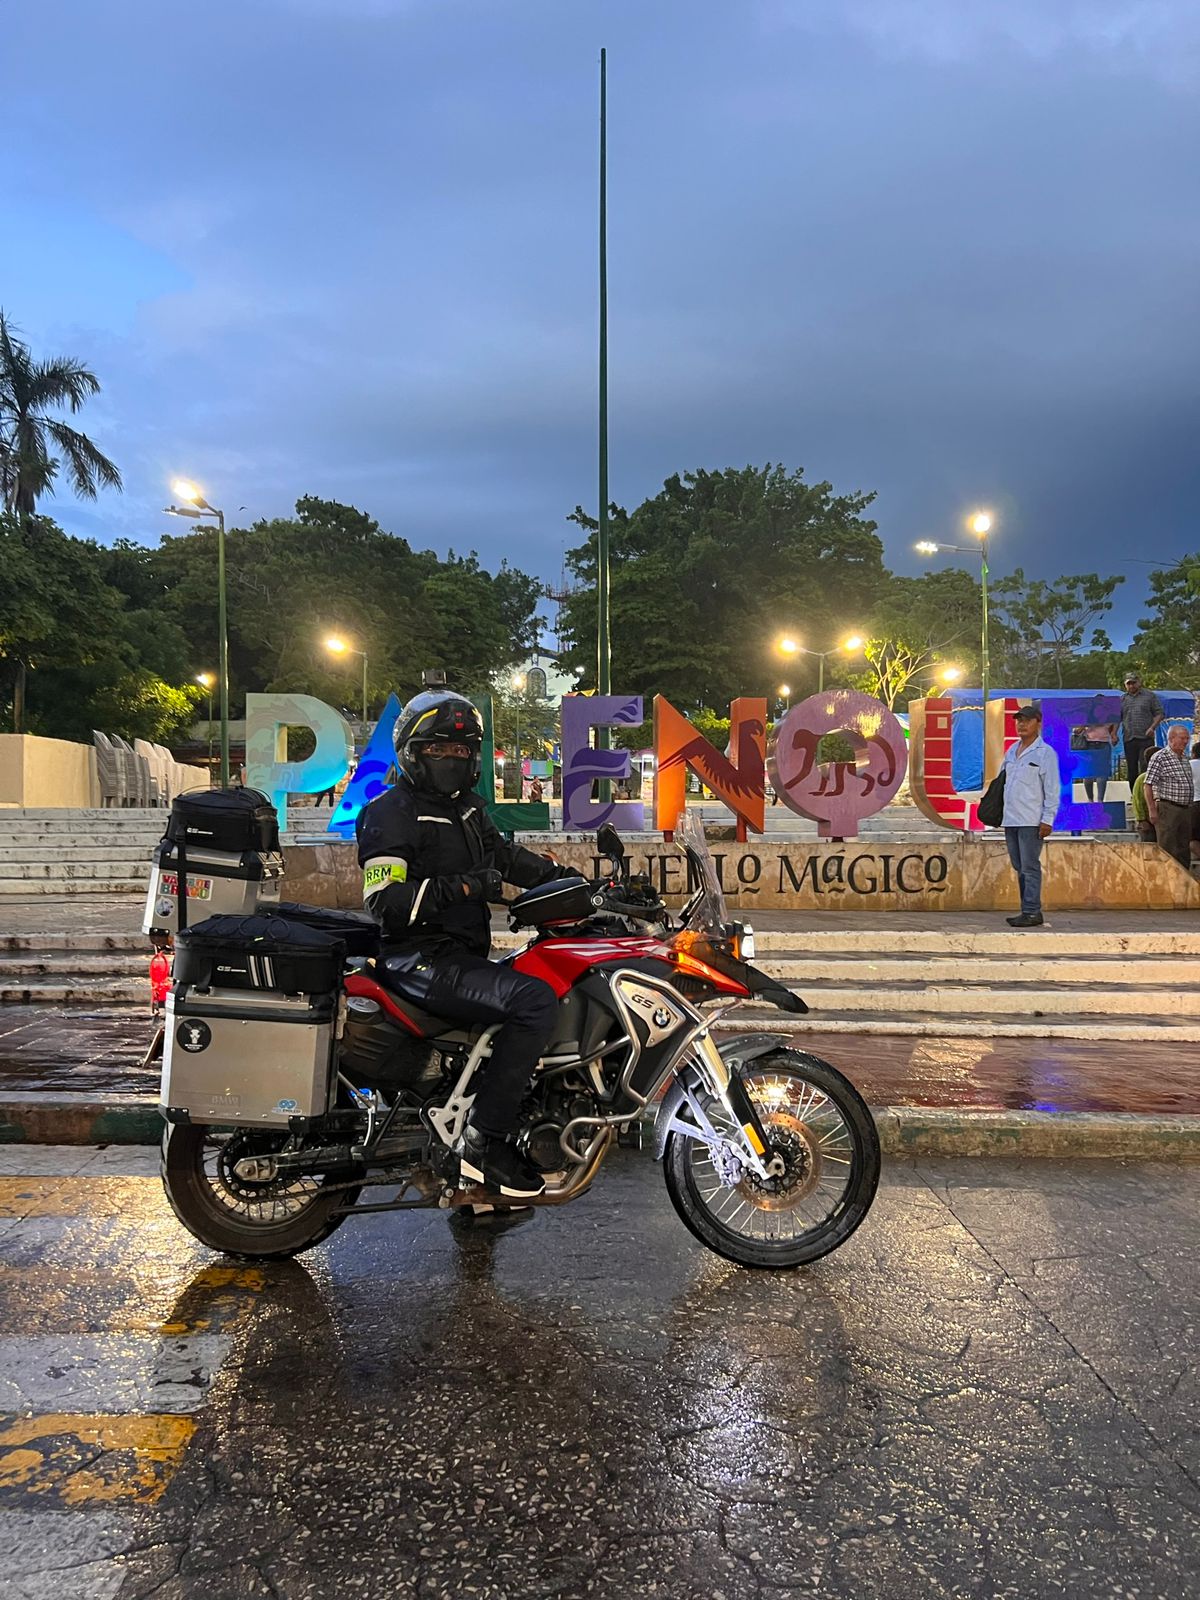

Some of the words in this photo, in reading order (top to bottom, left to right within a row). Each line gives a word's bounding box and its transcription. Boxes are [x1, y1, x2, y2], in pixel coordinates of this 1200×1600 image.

[366, 867, 392, 883] RRM
[160, 883, 210, 899] BRVO
[631, 994, 655, 1009] GS
